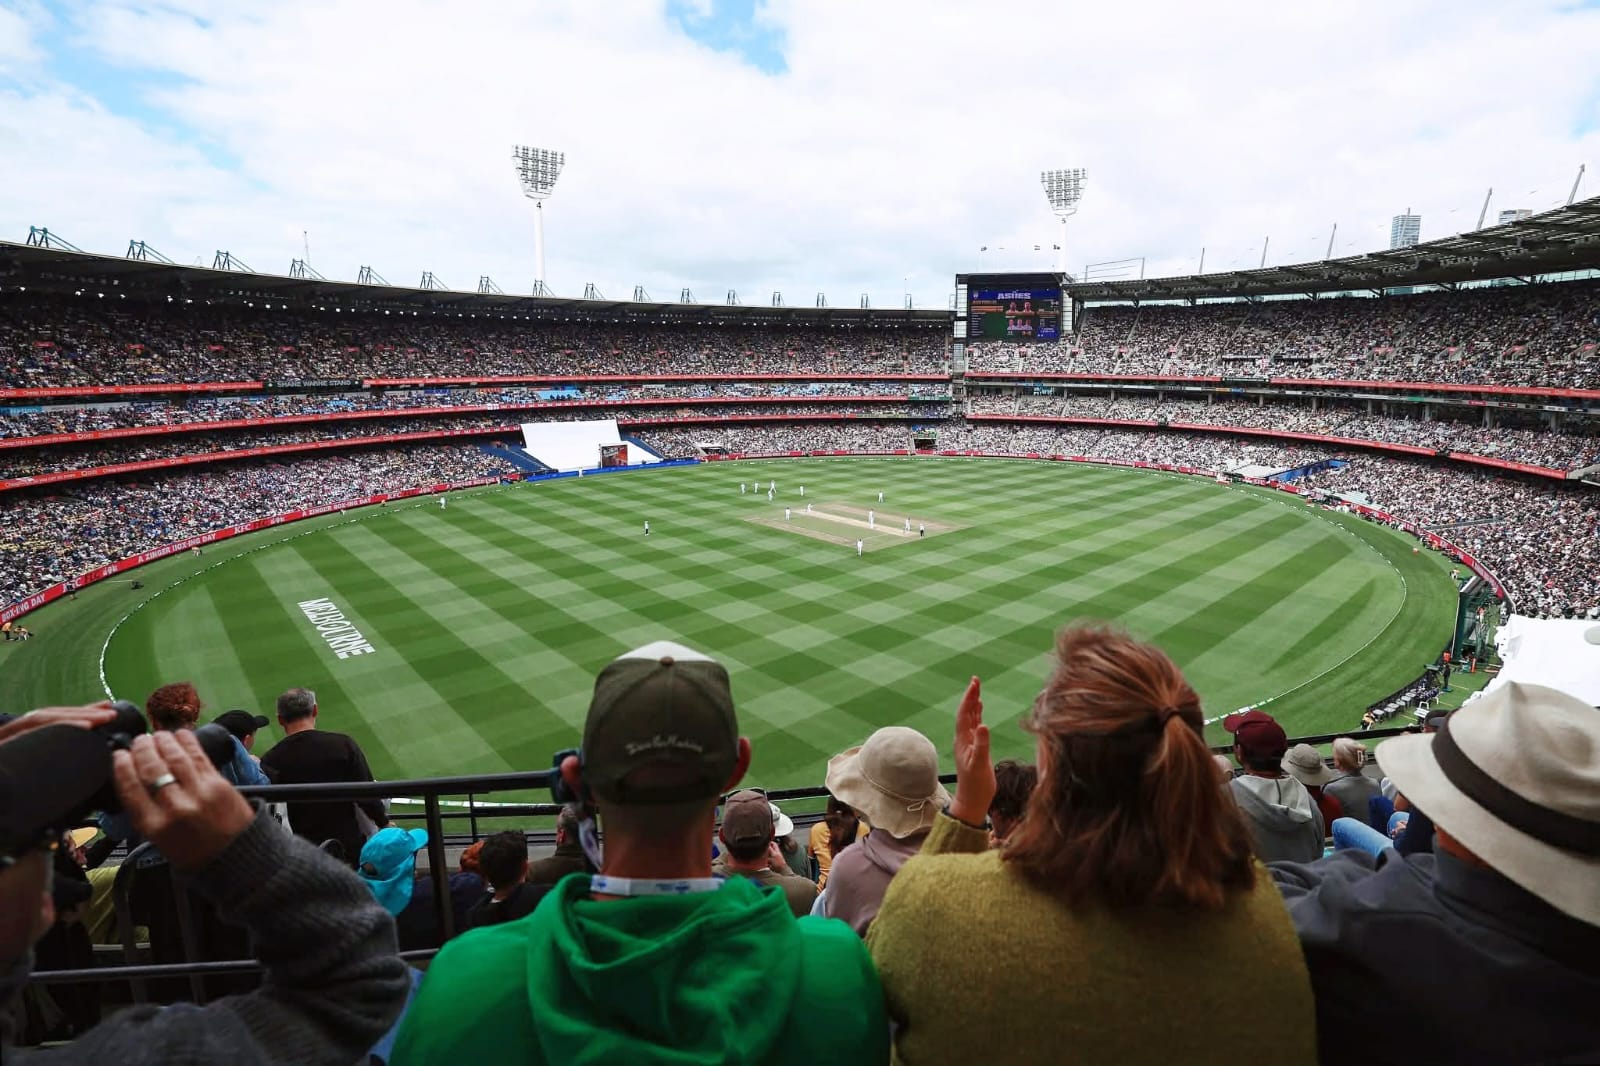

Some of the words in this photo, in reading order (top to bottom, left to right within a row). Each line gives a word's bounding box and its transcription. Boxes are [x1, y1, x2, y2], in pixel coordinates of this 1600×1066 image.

[202, 533, 217, 543] DAY
[234, 523, 251, 534] KFC
[31, 593, 46, 607] DAY
[297, 598, 375, 659] MELBOURNE
